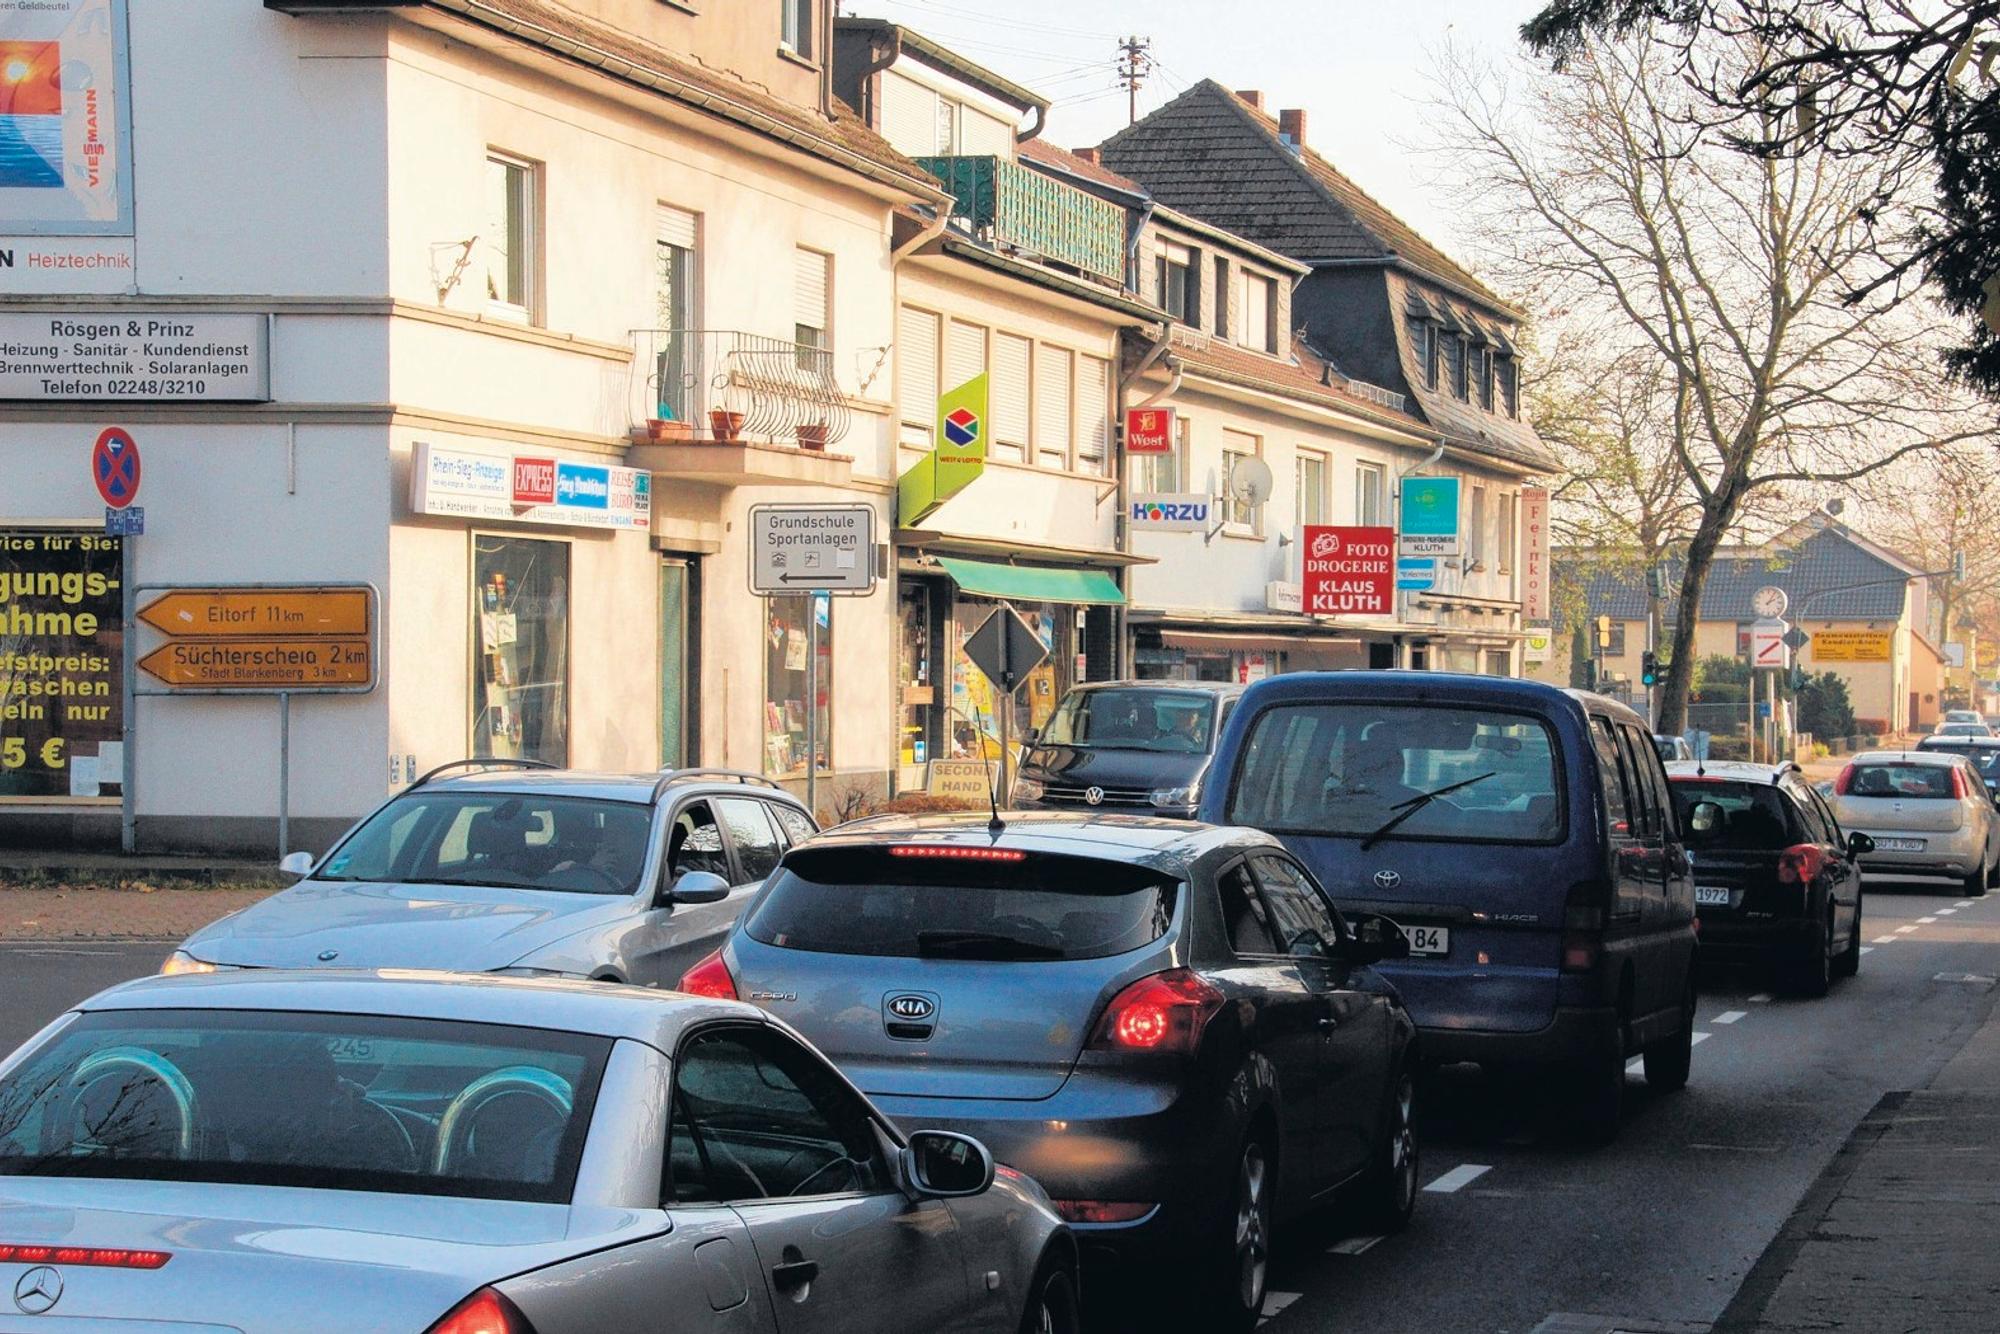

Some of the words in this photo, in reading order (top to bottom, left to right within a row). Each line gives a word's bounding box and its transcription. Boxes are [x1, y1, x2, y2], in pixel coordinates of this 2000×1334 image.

[18, 1, 70, 11] Geldbeutel
[83, 88, 105, 187] VIESSMANN
[28, 252, 130, 268] Heiztechnik
[51, 320, 121, 340] Rösgen
[127, 321, 141, 337] &
[148, 320, 195, 337] Prinz
[73, 343, 128, 356] Sanitär
[143, 343, 249, 356] Kundendienst
[0, 360, 134, 374] Brennwerttechnik
[149, 361, 249, 377] Solaranlagen
[41, 380, 102, 394] Telefon
[108, 380, 206, 396] 02248/3210
[1130, 433, 1165, 446] West
[515, 463, 553, 493] EXPRESS
[769, 515, 855, 529] Grundschule
[42, 535, 73, 551] für
[80, 534, 120, 551] Sie:
[767, 532, 857, 548] Sportanlagen
[1346, 543, 1389, 557] FOTO
[1414, 544, 1445, 552] KLUTH
[1307, 559, 1389, 574] DROGERIE
[1529, 505, 1540, 617] Feinkost
[1319, 580, 1376, 594] KLAUS
[1312, 594, 1382, 611] KLUTH
[208, 605, 257, 623] Eitorf
[267, 606, 280, 621] 11
[284, 609, 304, 622] km
[330, 645, 341, 664] 2
[345, 650, 366, 664] km
[201, 666, 231, 679] Stadt
[234, 666, 304, 681] Blankenberg
[312, 666, 320, 678] 3
[322, 666, 337, 677] km
[67, 705, 111, 720] nur
[40, 737, 65, 769] €
[934, 763, 993, 777] SECOND
[941, 781, 982, 792] HAND
[1697, 889, 1728, 902] 1972
[1414, 928, 1439, 950] 84
[896, 1001, 926, 1014] KIA
